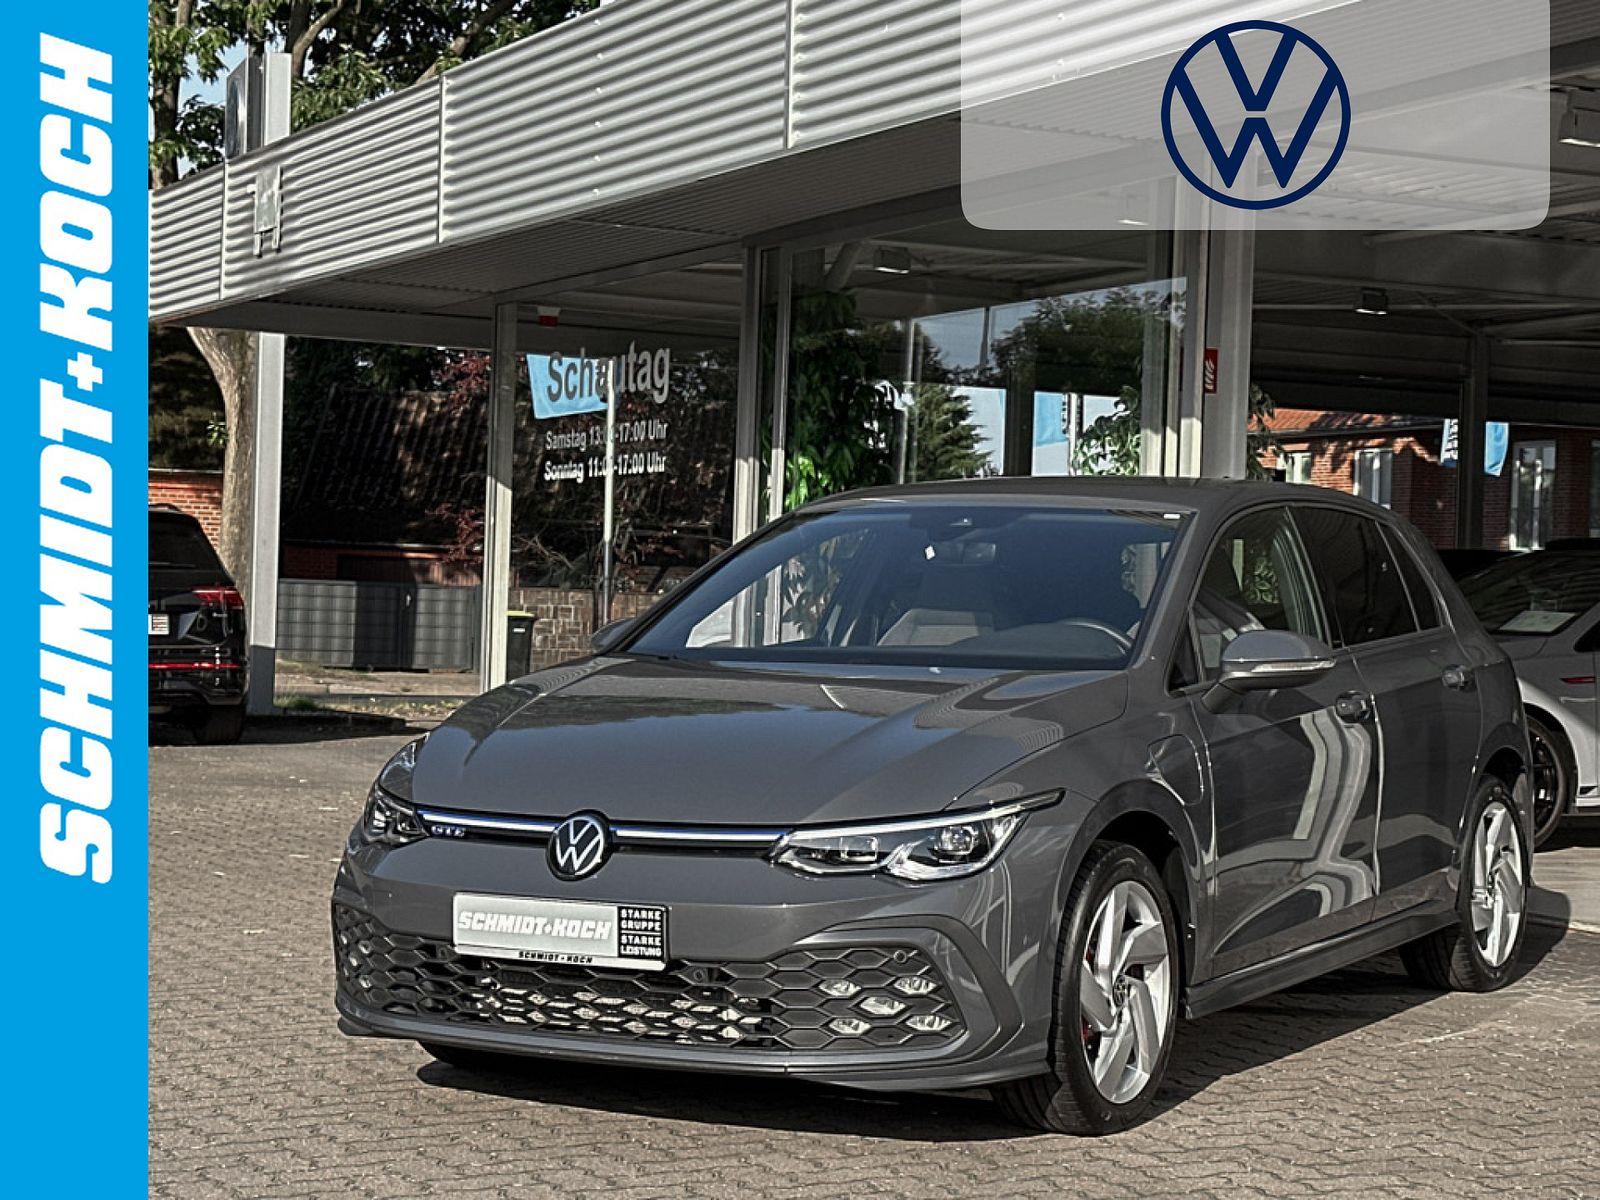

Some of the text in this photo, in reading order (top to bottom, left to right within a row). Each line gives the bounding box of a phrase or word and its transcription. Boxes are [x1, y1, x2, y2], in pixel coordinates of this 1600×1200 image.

[547, 340, 670, 404] Schautag
[546, 418, 668, 452] Samstag 13:0-17:00 Uhr
[544, 450, 667, 483] Sonntag 11:0-17:00 Uhr
[621, 908, 661, 921] STARKE
[621, 919, 661, 932] GRUPPE
[621, 934, 661, 946] STARKE
